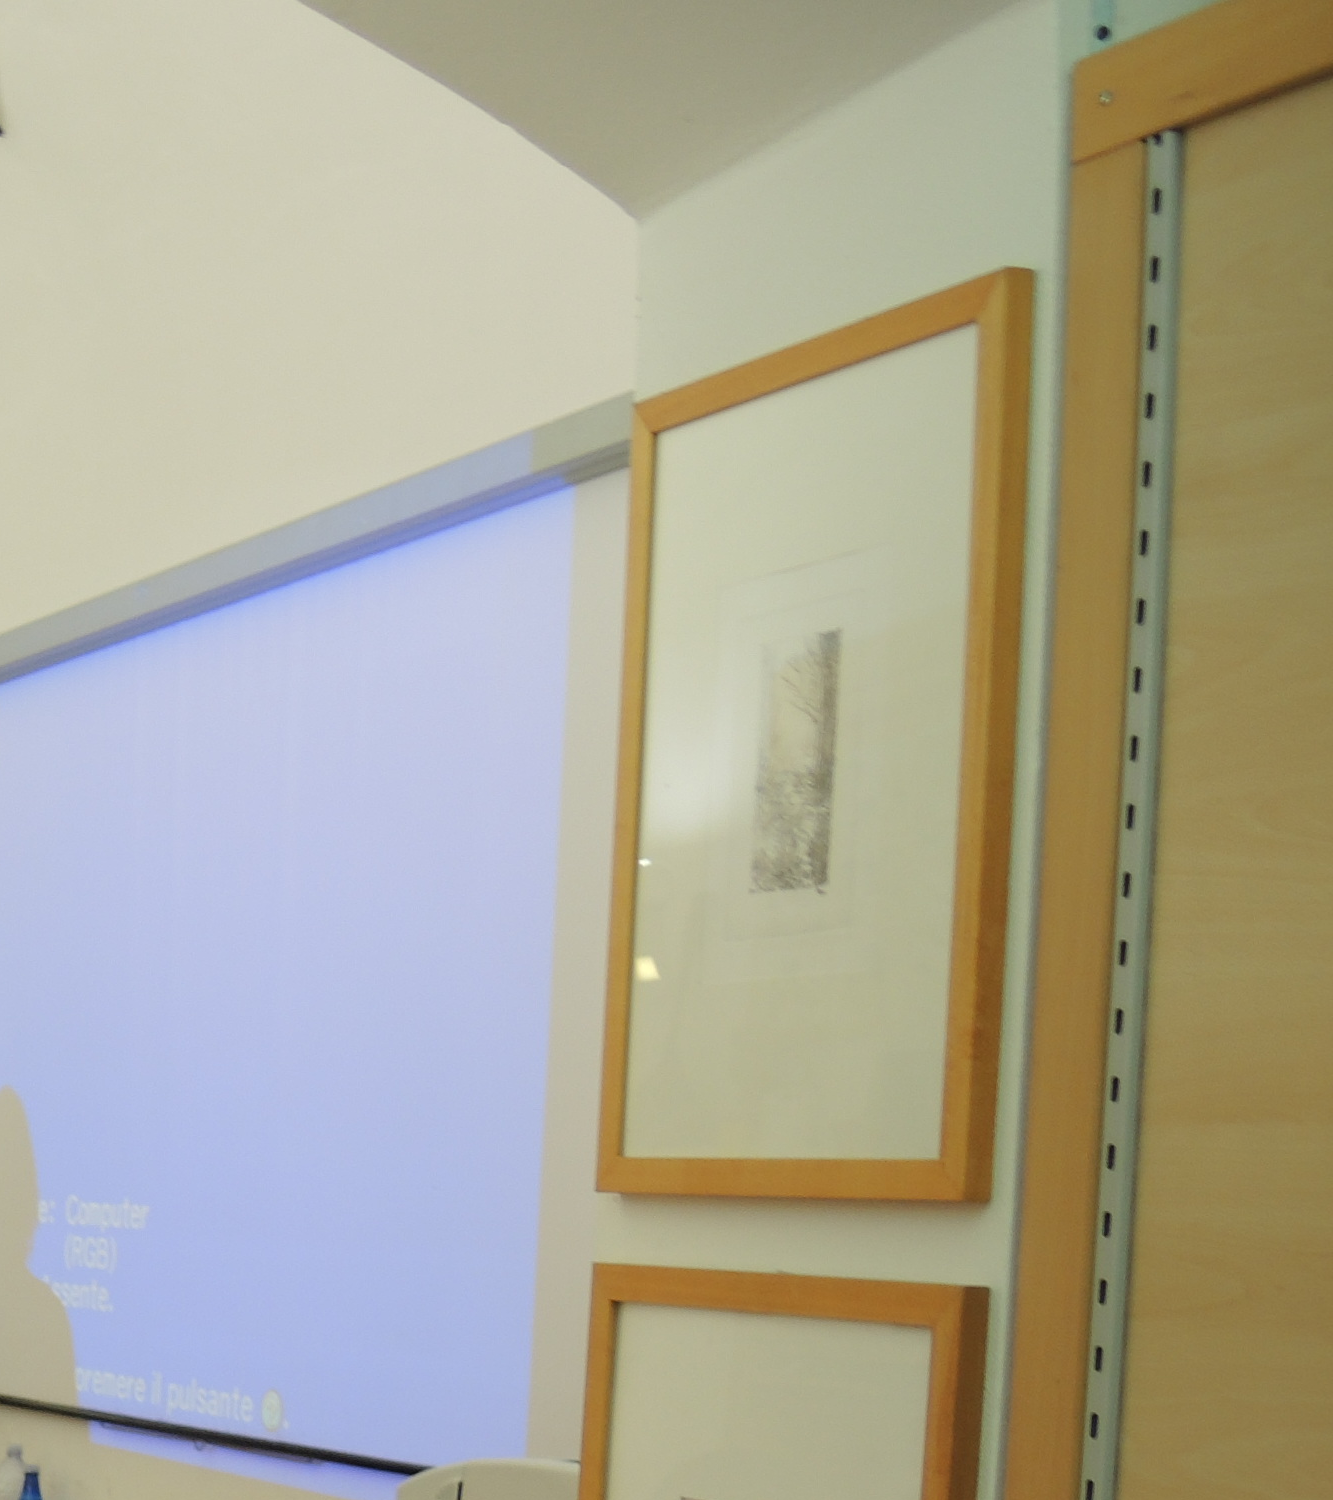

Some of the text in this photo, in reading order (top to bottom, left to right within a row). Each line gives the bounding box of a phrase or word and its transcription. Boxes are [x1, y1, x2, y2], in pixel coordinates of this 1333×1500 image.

[65, 1195, 150, 1232] Computer
[63, 1233, 117, 1274] (RGB)
[150, 1370, 163, 1405] il
[165, 1378, 254, 1423] pulsante
